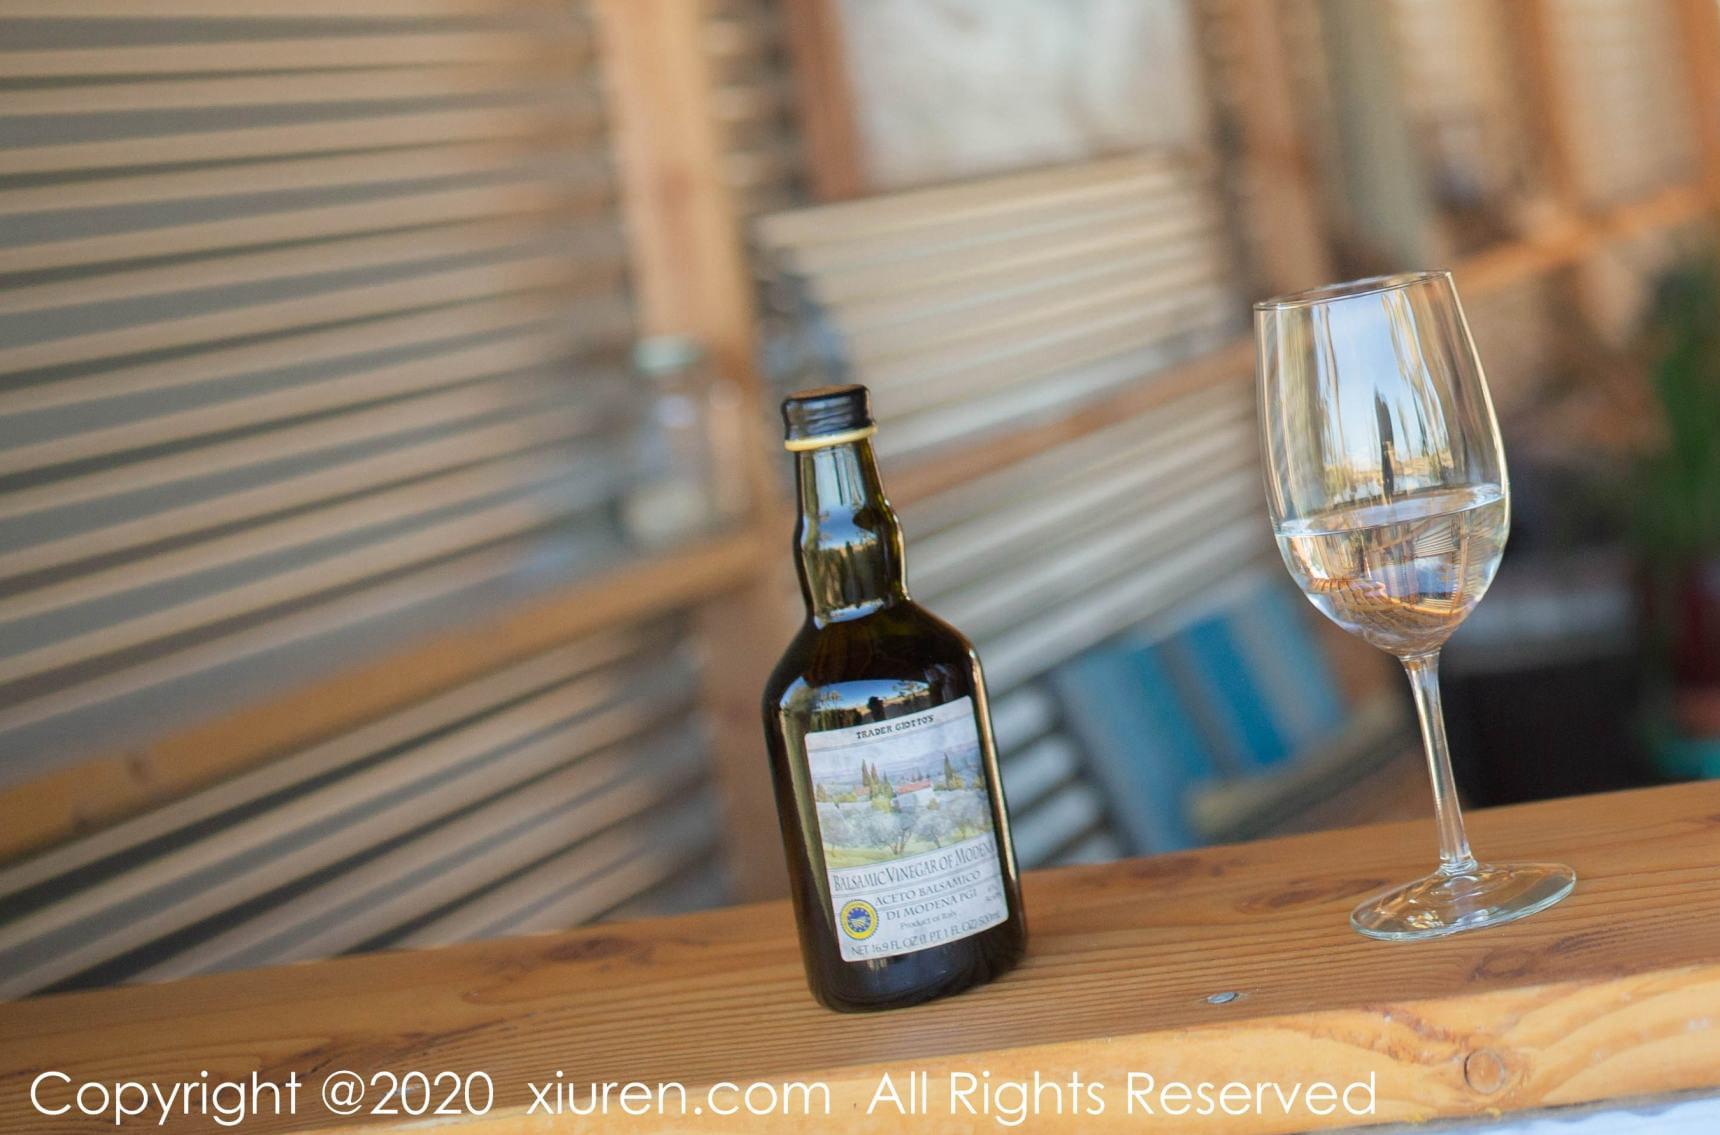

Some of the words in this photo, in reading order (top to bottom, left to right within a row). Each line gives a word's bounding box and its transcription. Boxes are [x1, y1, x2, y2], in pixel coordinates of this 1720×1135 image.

[856, 725, 893, 739] TRADER
[832, 868, 886, 892] BALSAMIC
[885, 860, 940, 883] VINEGAR
[940, 854, 954, 871] OF
[875, 889, 916, 906] ACETO
[919, 870, 982, 897] BALSAMICO
[886, 910, 901, 921] DI
[903, 895, 958, 916] MODENA
